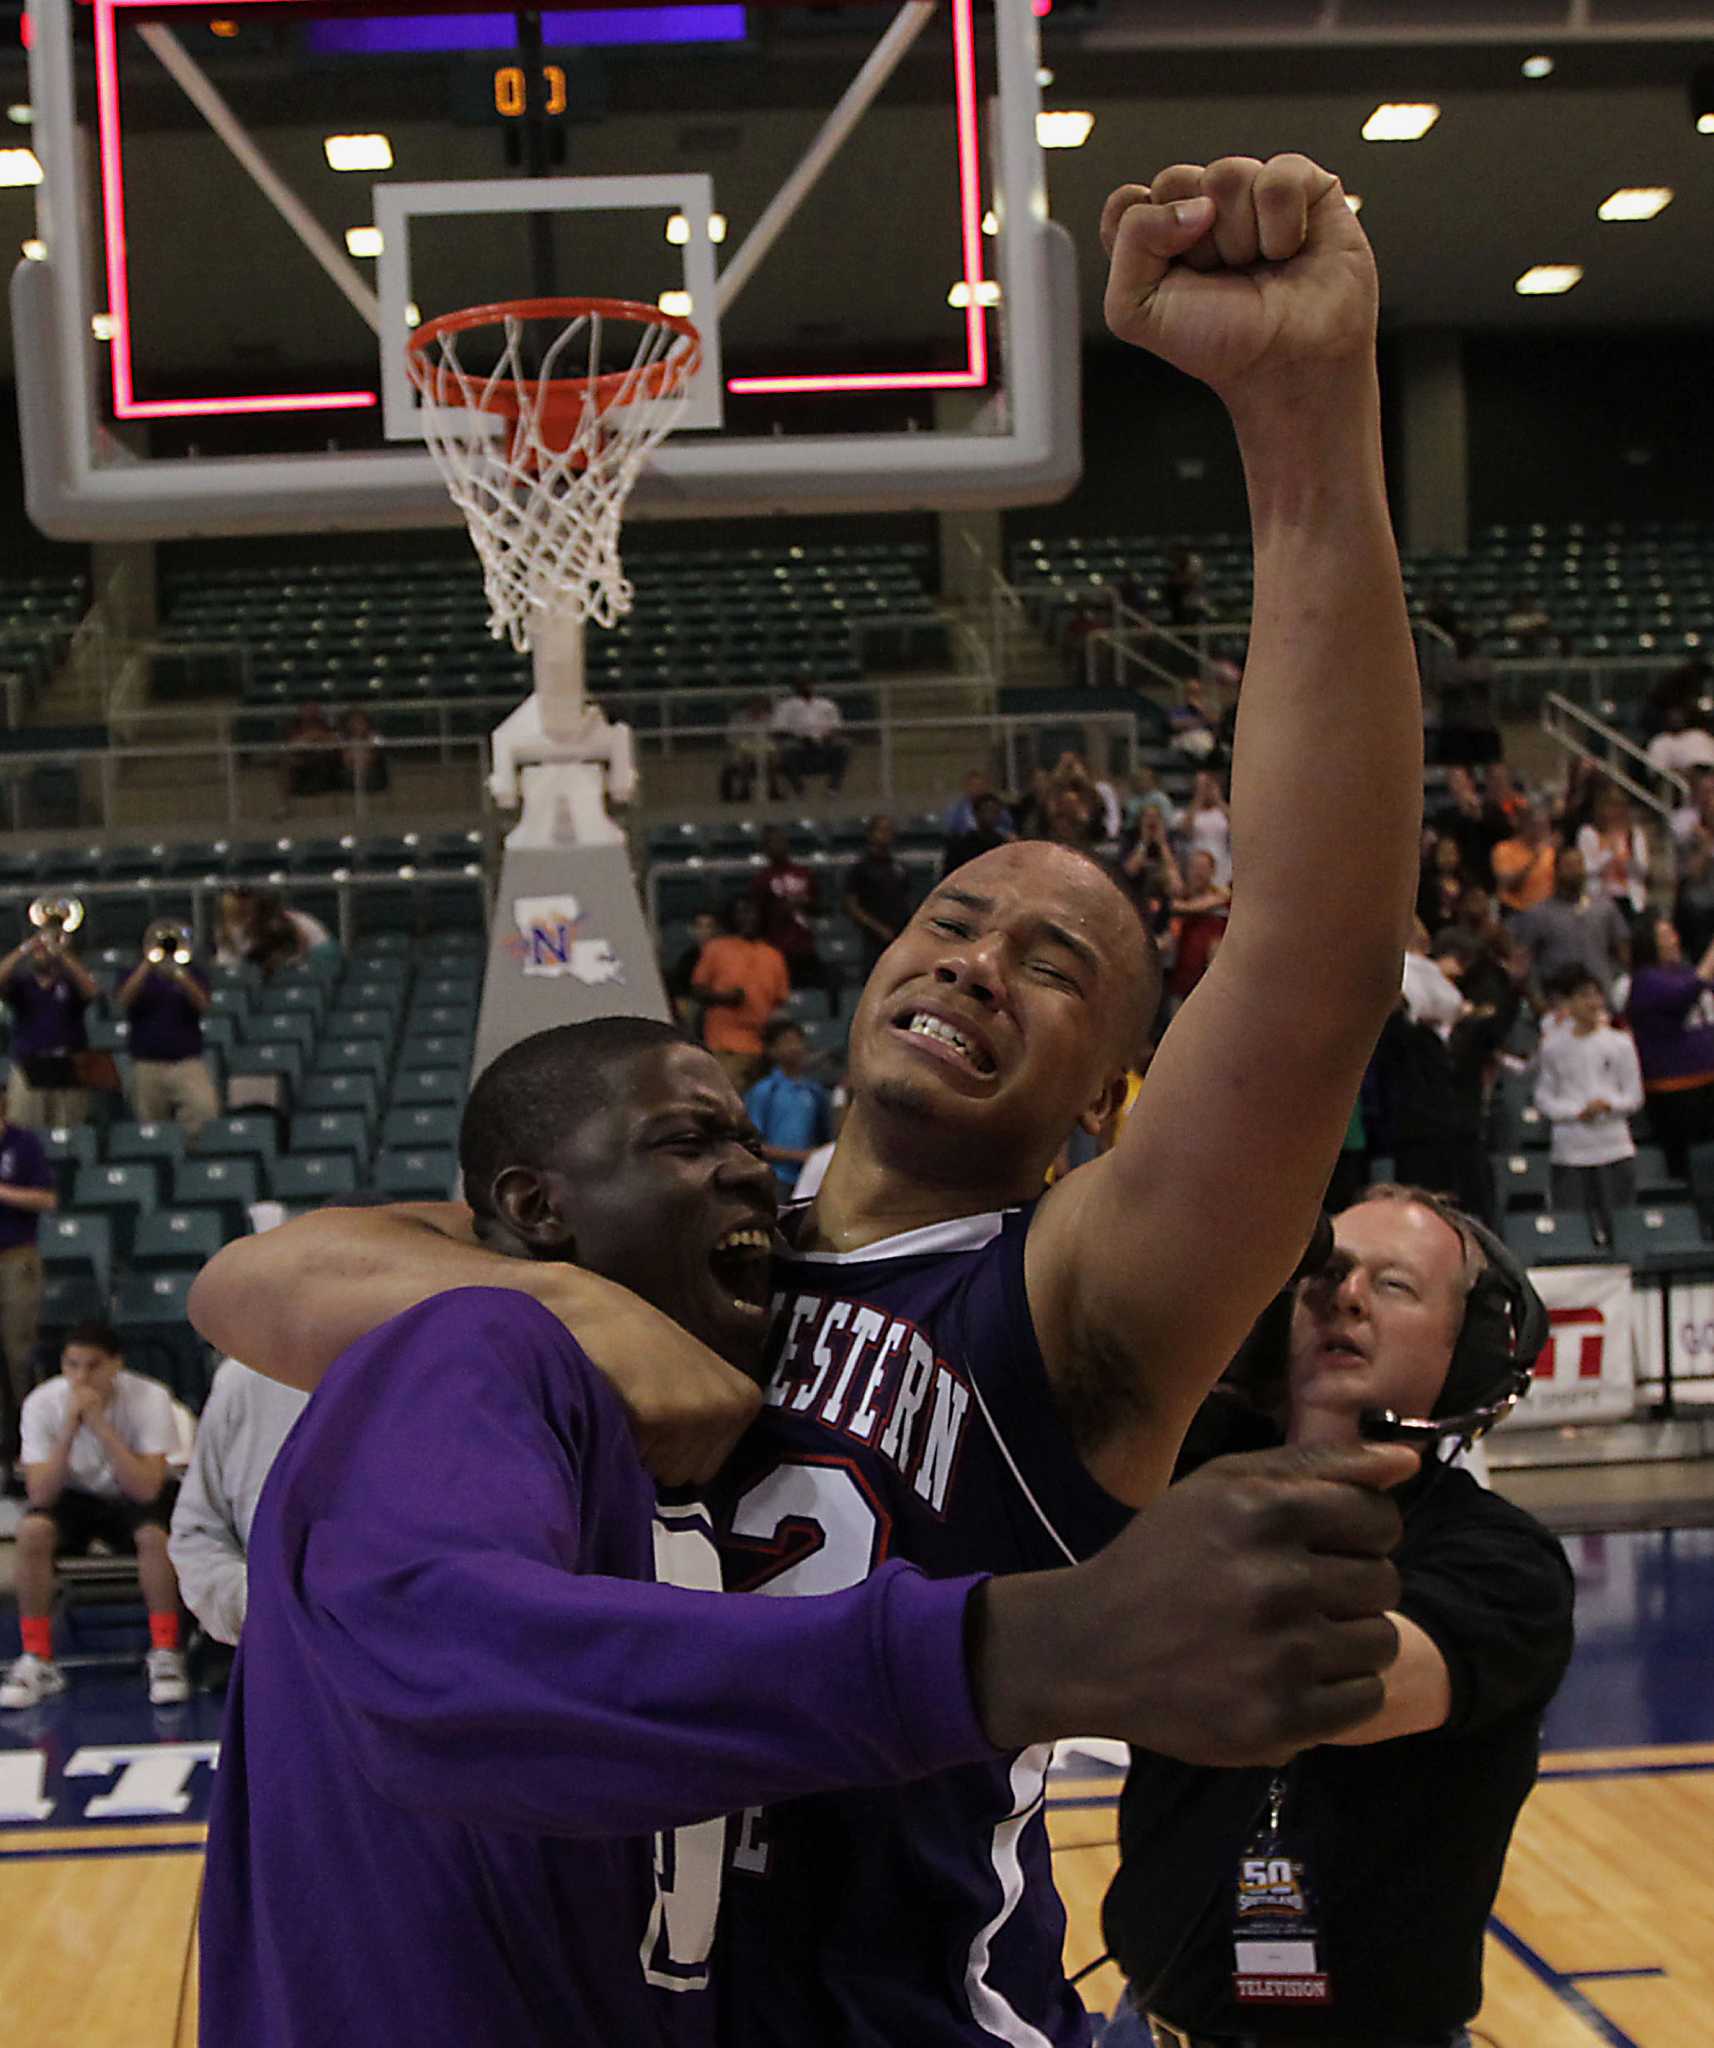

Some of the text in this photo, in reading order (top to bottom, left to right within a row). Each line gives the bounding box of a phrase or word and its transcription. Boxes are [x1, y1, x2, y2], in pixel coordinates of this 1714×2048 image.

[764, 1292, 970, 1514] ESTERN
[1243, 1860, 1292, 1896] 50
[1237, 1980, 1326, 1998] TELEVISION
